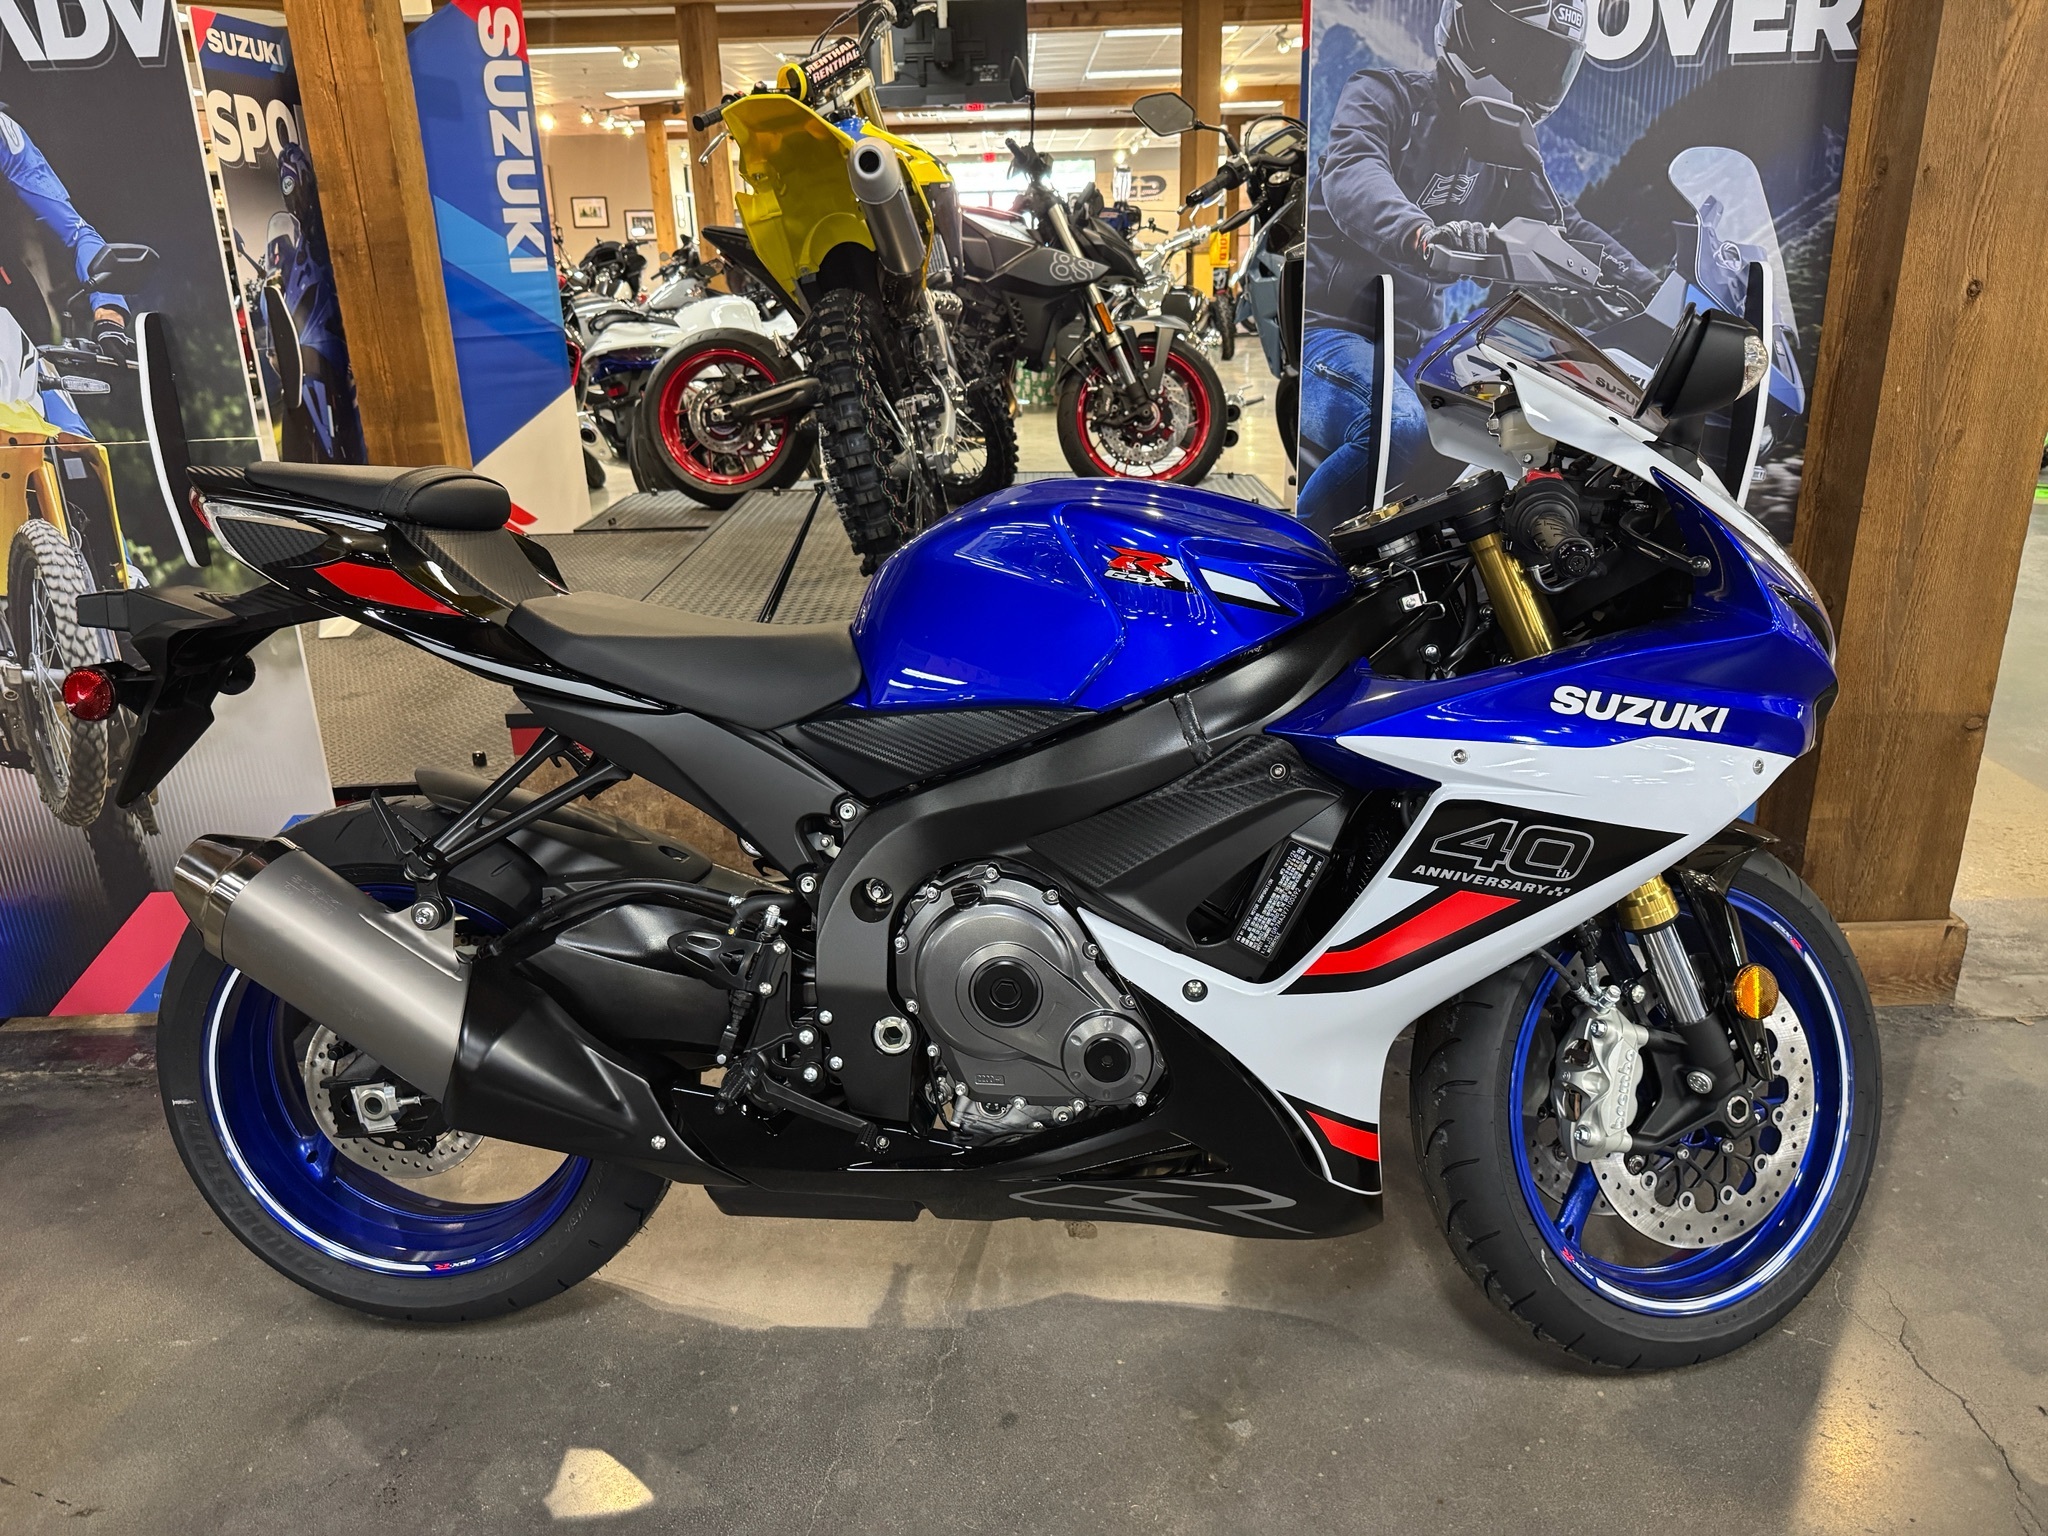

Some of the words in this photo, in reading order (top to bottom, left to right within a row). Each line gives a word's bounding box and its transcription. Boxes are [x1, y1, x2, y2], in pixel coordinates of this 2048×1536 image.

[205, 28, 284, 66] SUZUKI
[1582, 0, 1858, 60] OVER
[805, 41, 856, 74] RENTHAL
[812, 48, 860, 83] RENTHAL
[206, 90, 308, 163] SPO
[478, 5, 549, 273] SUZUKI
[1550, 685, 1730, 733] SUZUKI
[1430, 818, 1595, 881] 40
[1412, 865, 1549, 894] ANNIVERSARY
[1610, 1049, 1636, 1130] brembo
